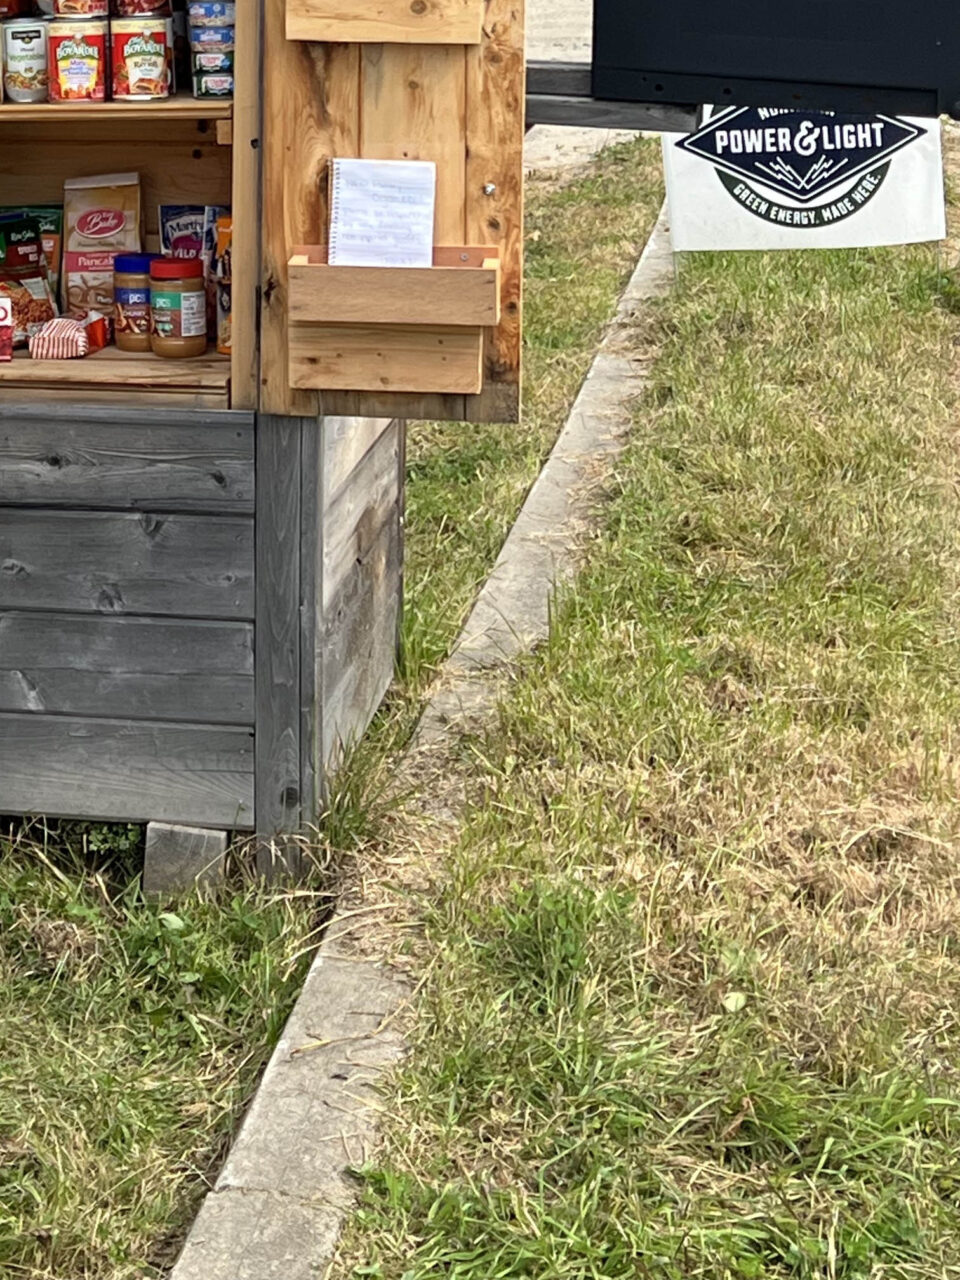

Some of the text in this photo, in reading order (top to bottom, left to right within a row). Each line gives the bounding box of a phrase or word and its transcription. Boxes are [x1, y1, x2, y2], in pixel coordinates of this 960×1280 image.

[715, 120, 884, 156] POWER & LIGHT
[733, 183, 769, 215] GREEN
[821, 198, 854, 221] MADE
